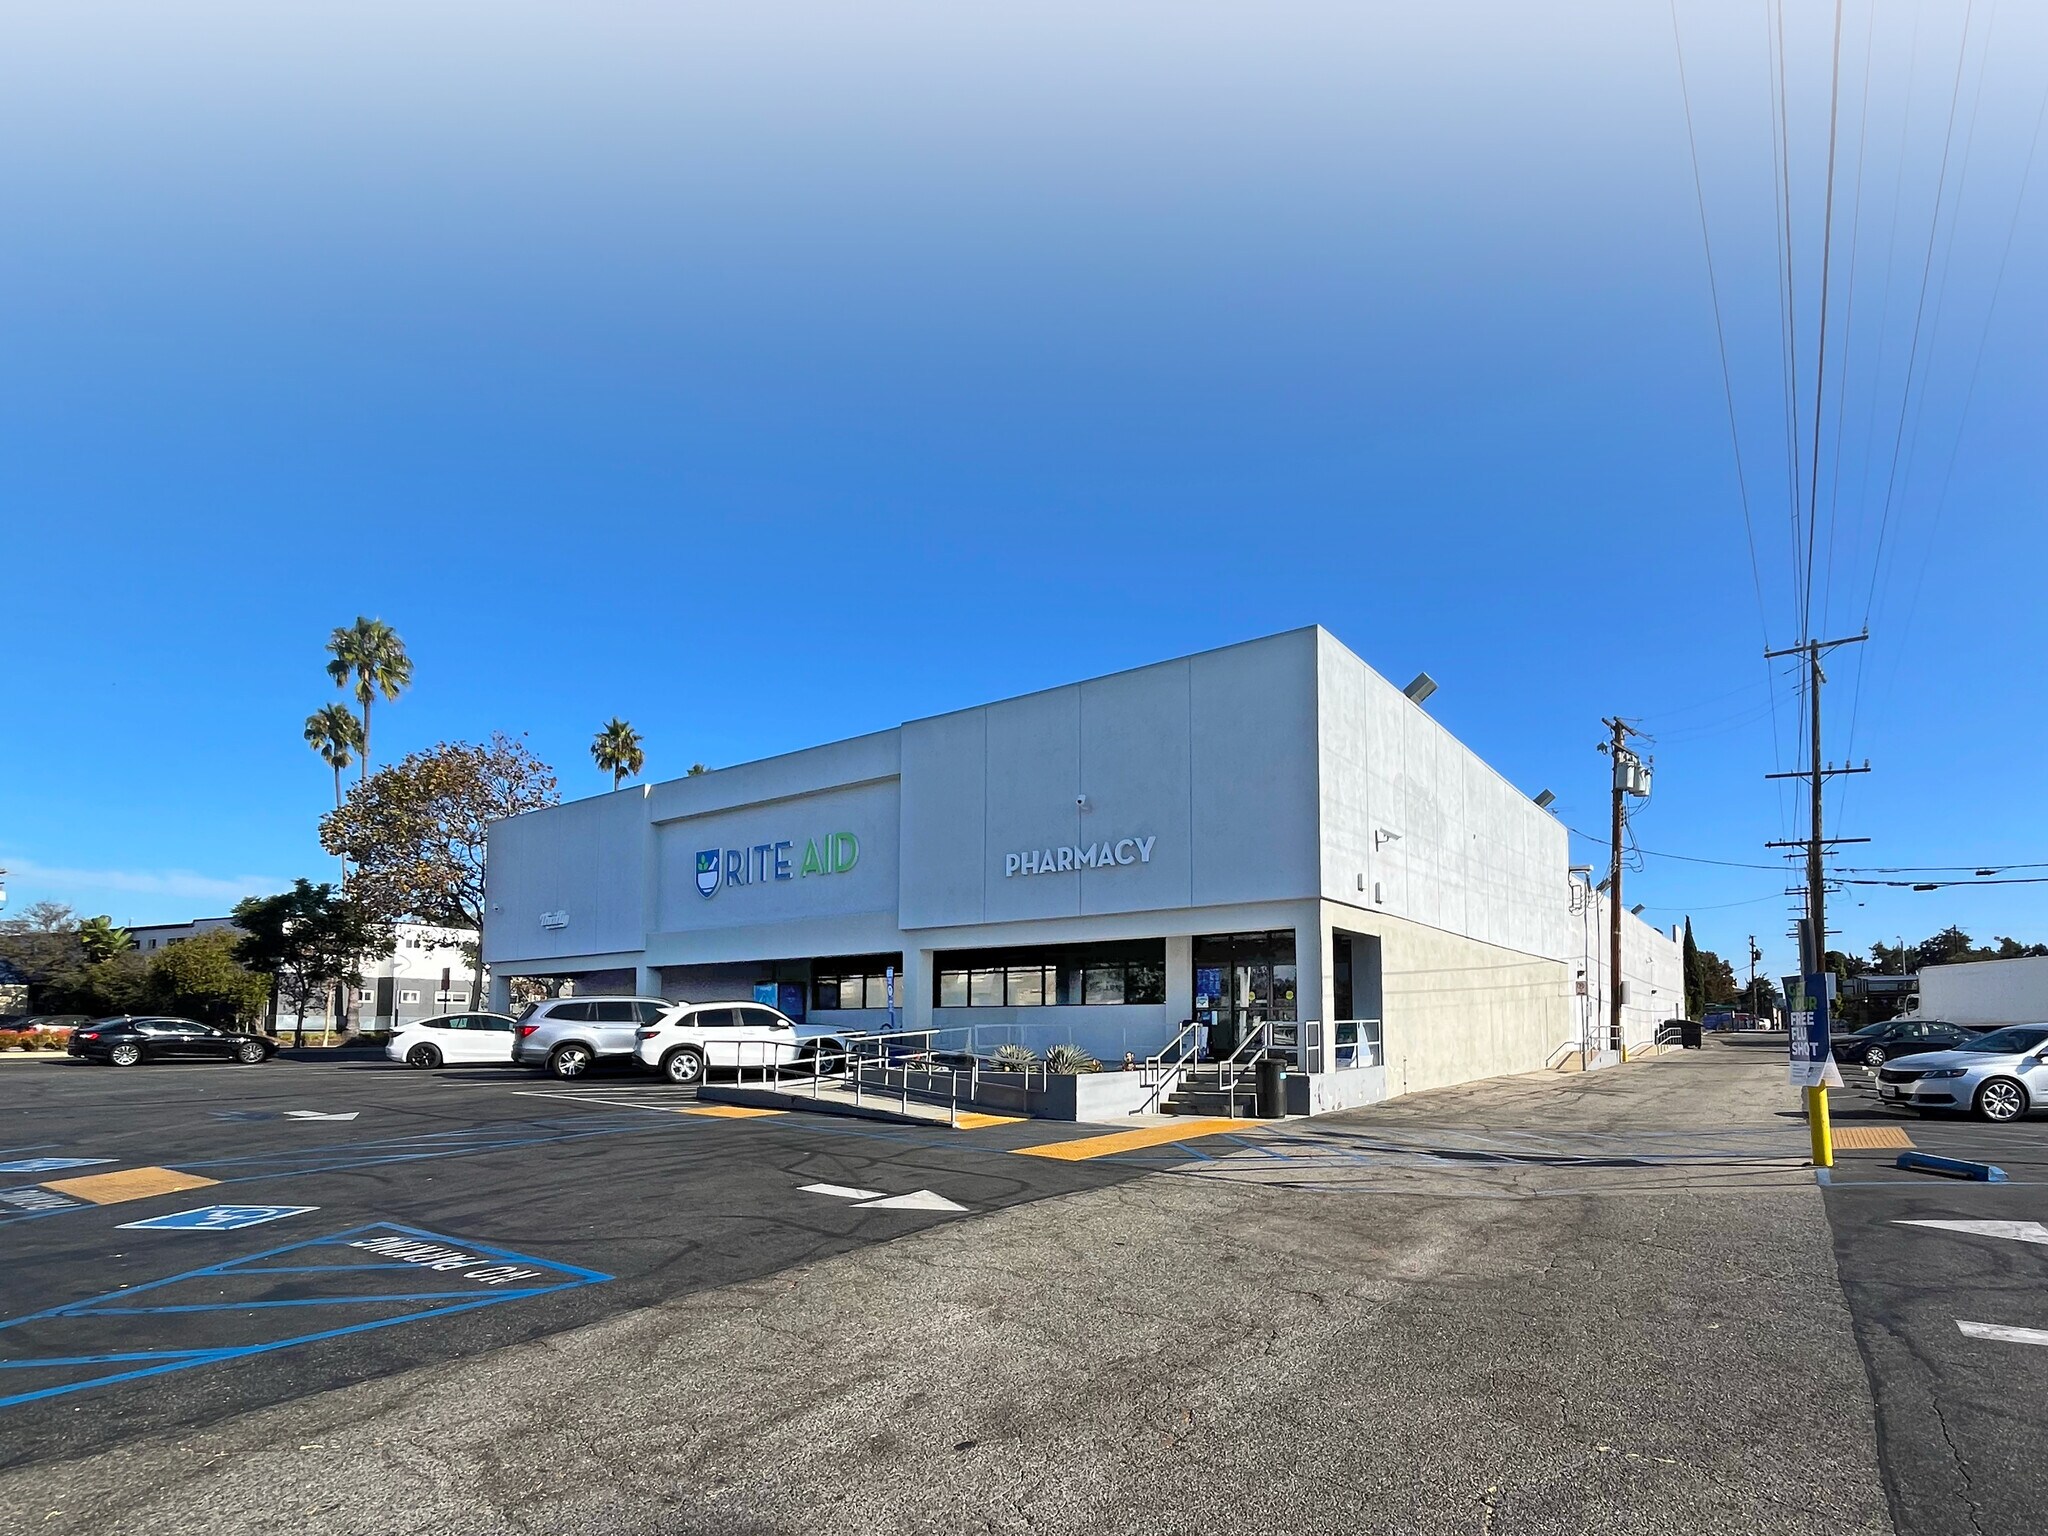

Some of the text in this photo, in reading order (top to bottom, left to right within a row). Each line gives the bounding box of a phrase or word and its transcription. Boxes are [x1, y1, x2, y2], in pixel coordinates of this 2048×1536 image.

[726, 831, 859, 887] RITE AID
[1005, 836, 1156, 877] PHARMACY
[1788, 996, 1817, 1011] YOUR
[1790, 1011, 1815, 1026] FREE
[1791, 1026, 1807, 1041] FLU
[1791, 1042, 1819, 1056] SHOT
[348, 1236, 542, 1285] NO PARKING
